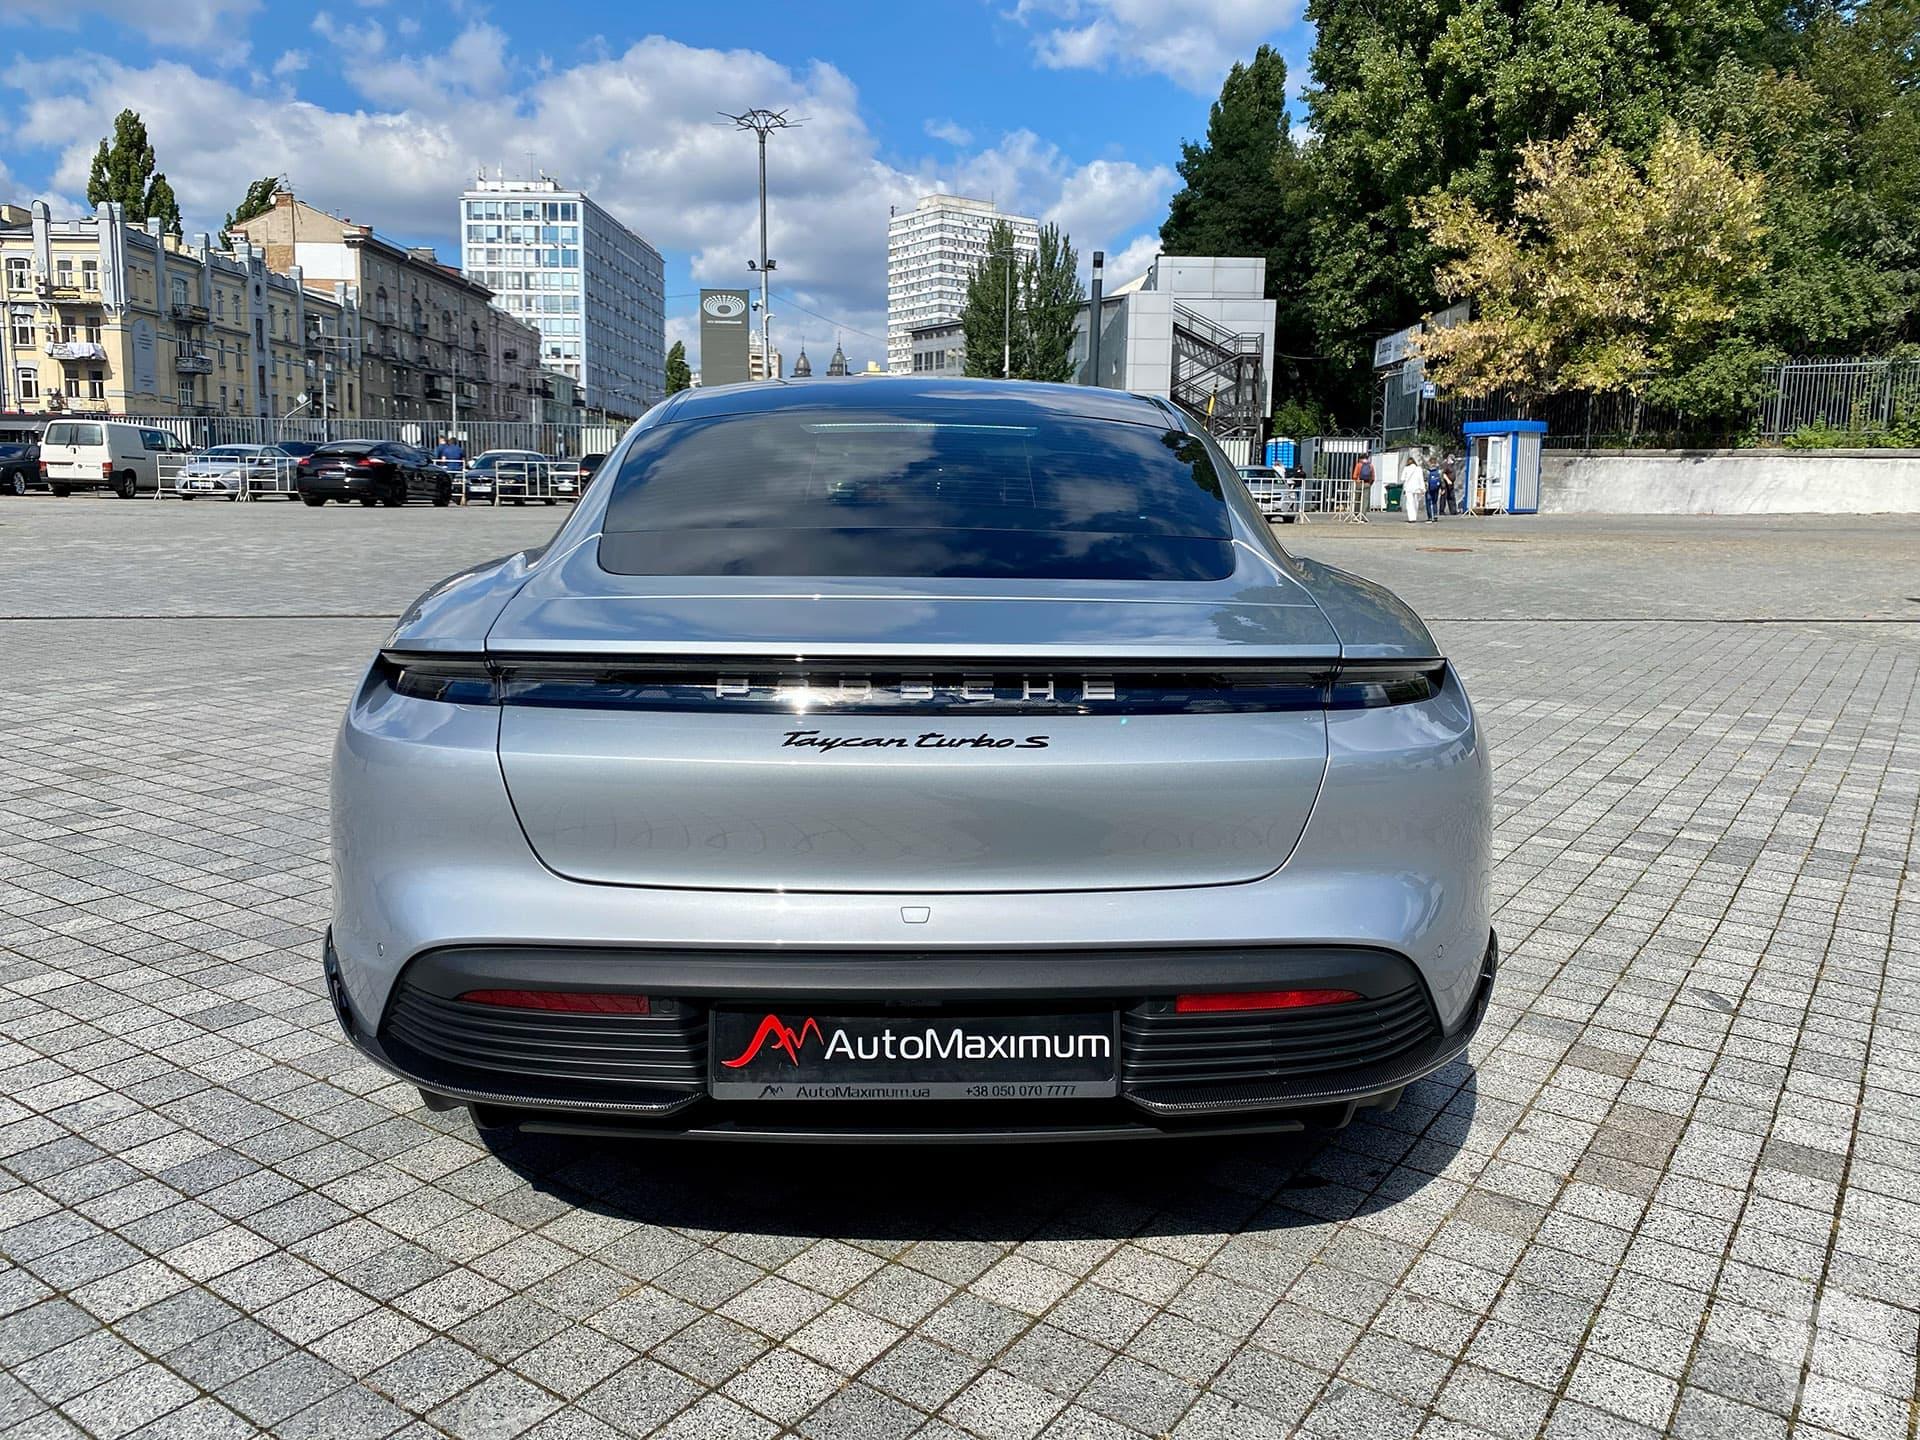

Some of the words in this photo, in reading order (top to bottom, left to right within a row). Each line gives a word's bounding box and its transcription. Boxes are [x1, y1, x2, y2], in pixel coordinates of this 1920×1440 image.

[782, 730, 909, 753] Taycan
[914, 733, 1015, 748] turbo
[1015, 736, 1050, 748] S
[824, 1028, 1111, 1061] AutoMaximum
[796, 1085, 930, 1098] AutoMaximum.ua
[966, 1086, 988, 1097] +38
[992, 1086, 1015, 1097] 050
[1019, 1086, 1042, 1097] 070
[1047, 1085, 1076, 1096] 7777
